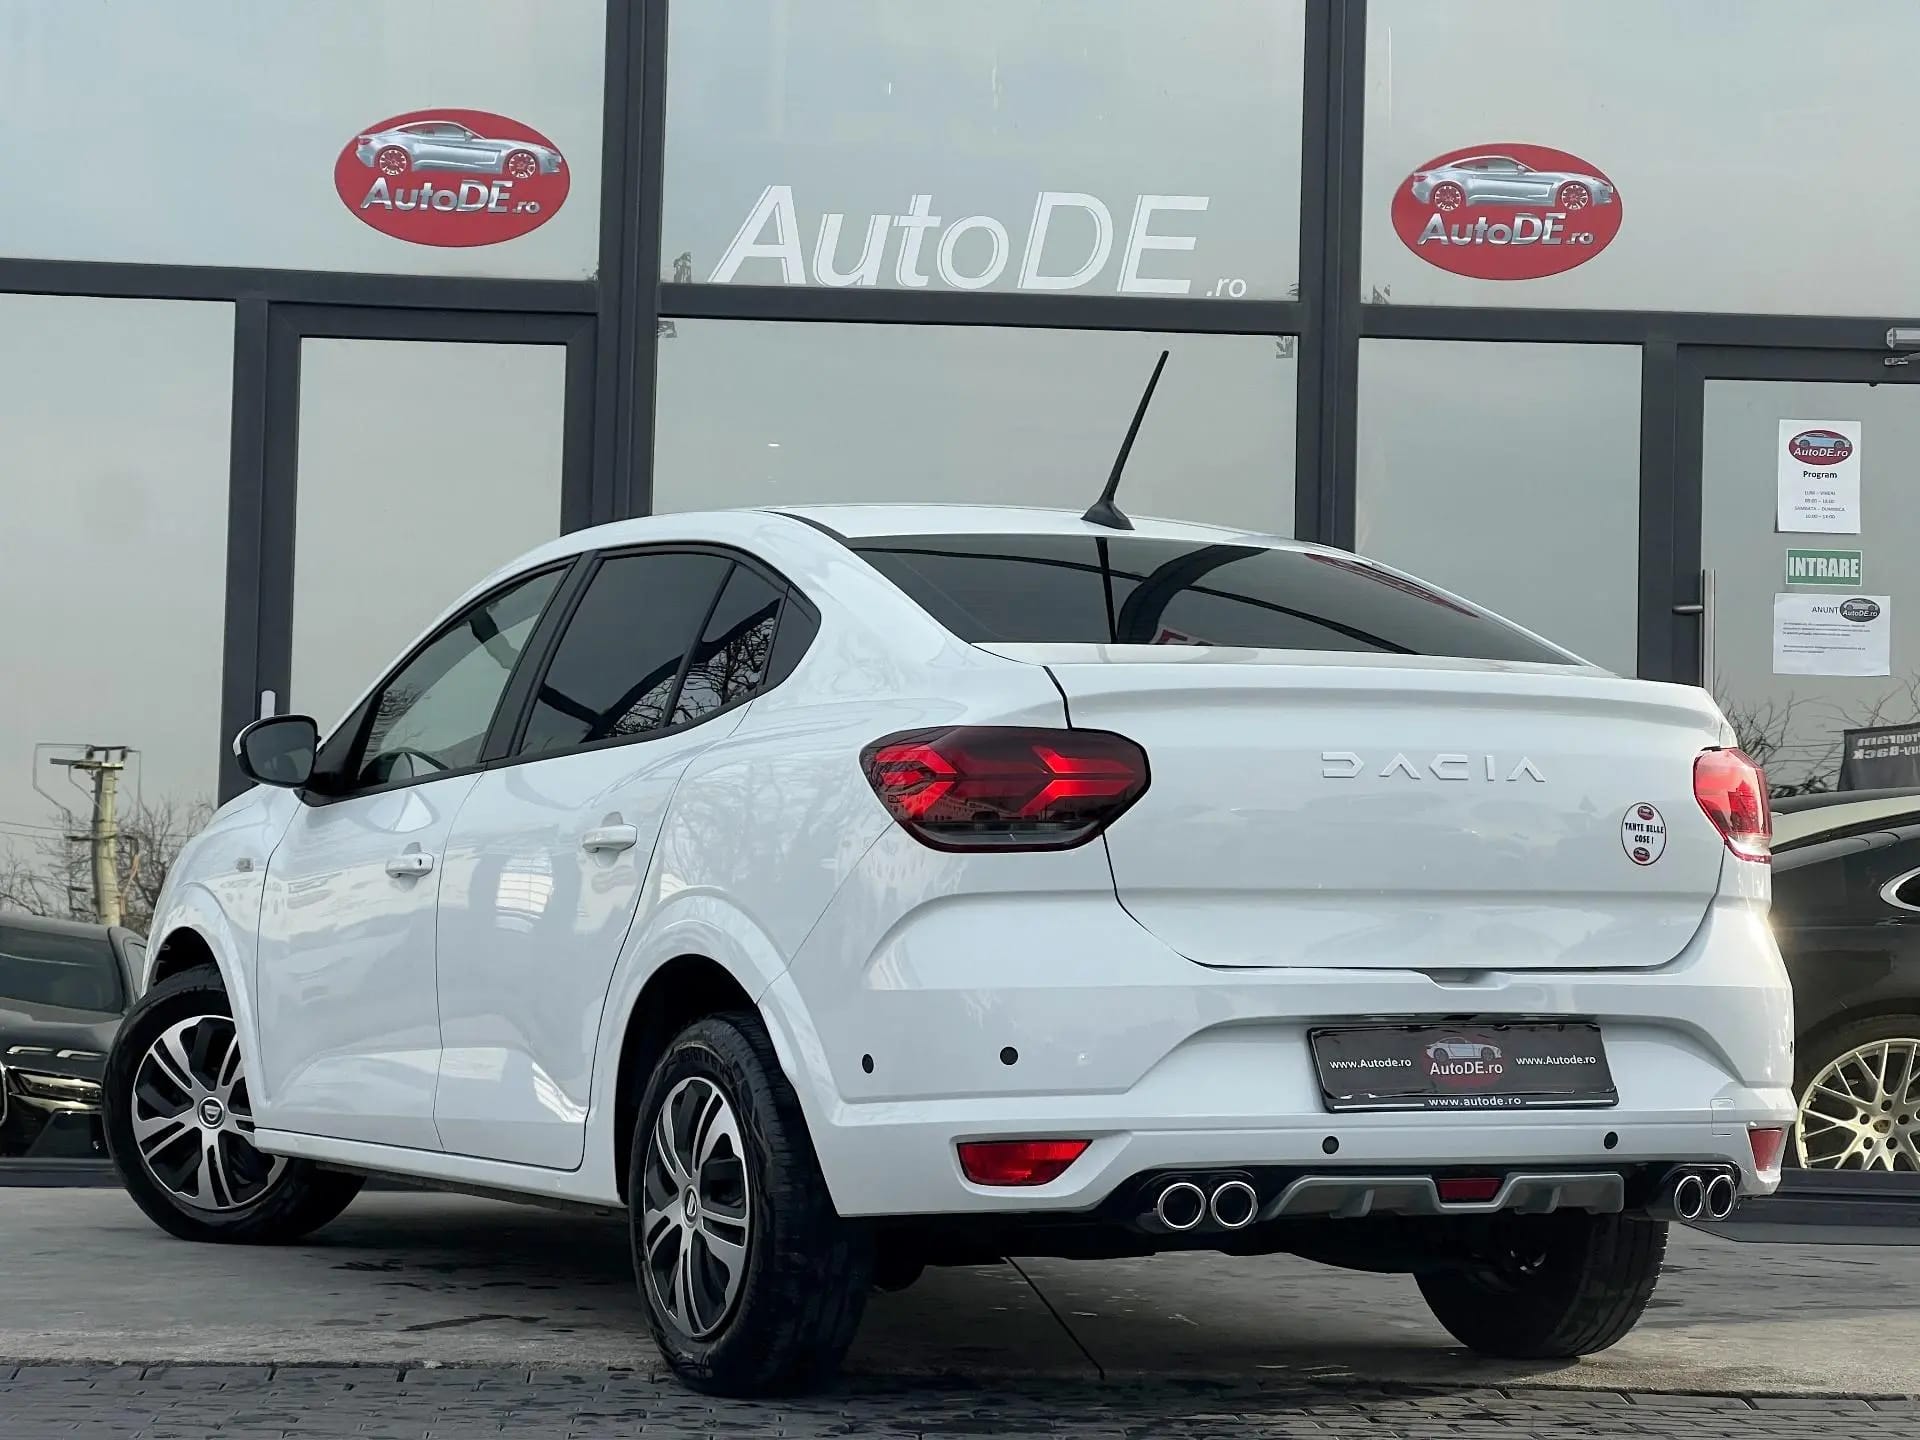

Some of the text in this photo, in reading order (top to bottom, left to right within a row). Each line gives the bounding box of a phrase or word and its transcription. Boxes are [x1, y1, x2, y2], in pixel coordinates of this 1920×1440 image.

[1793, 447, 1849, 458] AutoDE.ro
[1803, 470, 1838, 480] Program
[1788, 556, 1860, 578] INTRARE
[1321, 751, 1546, 783] DACIA
[1625, 822, 1664, 834] TANTE BELLE
[1634, 834, 1650, 844] COSE
[1330, 1057, 1412, 1070] www.Autode.ro
[1515, 1054, 1597, 1066] www.Autode.ro
[1429, 1061, 1503, 1075] AutoDE.ro
[1428, 1096, 1522, 1107] www.autode.ro
